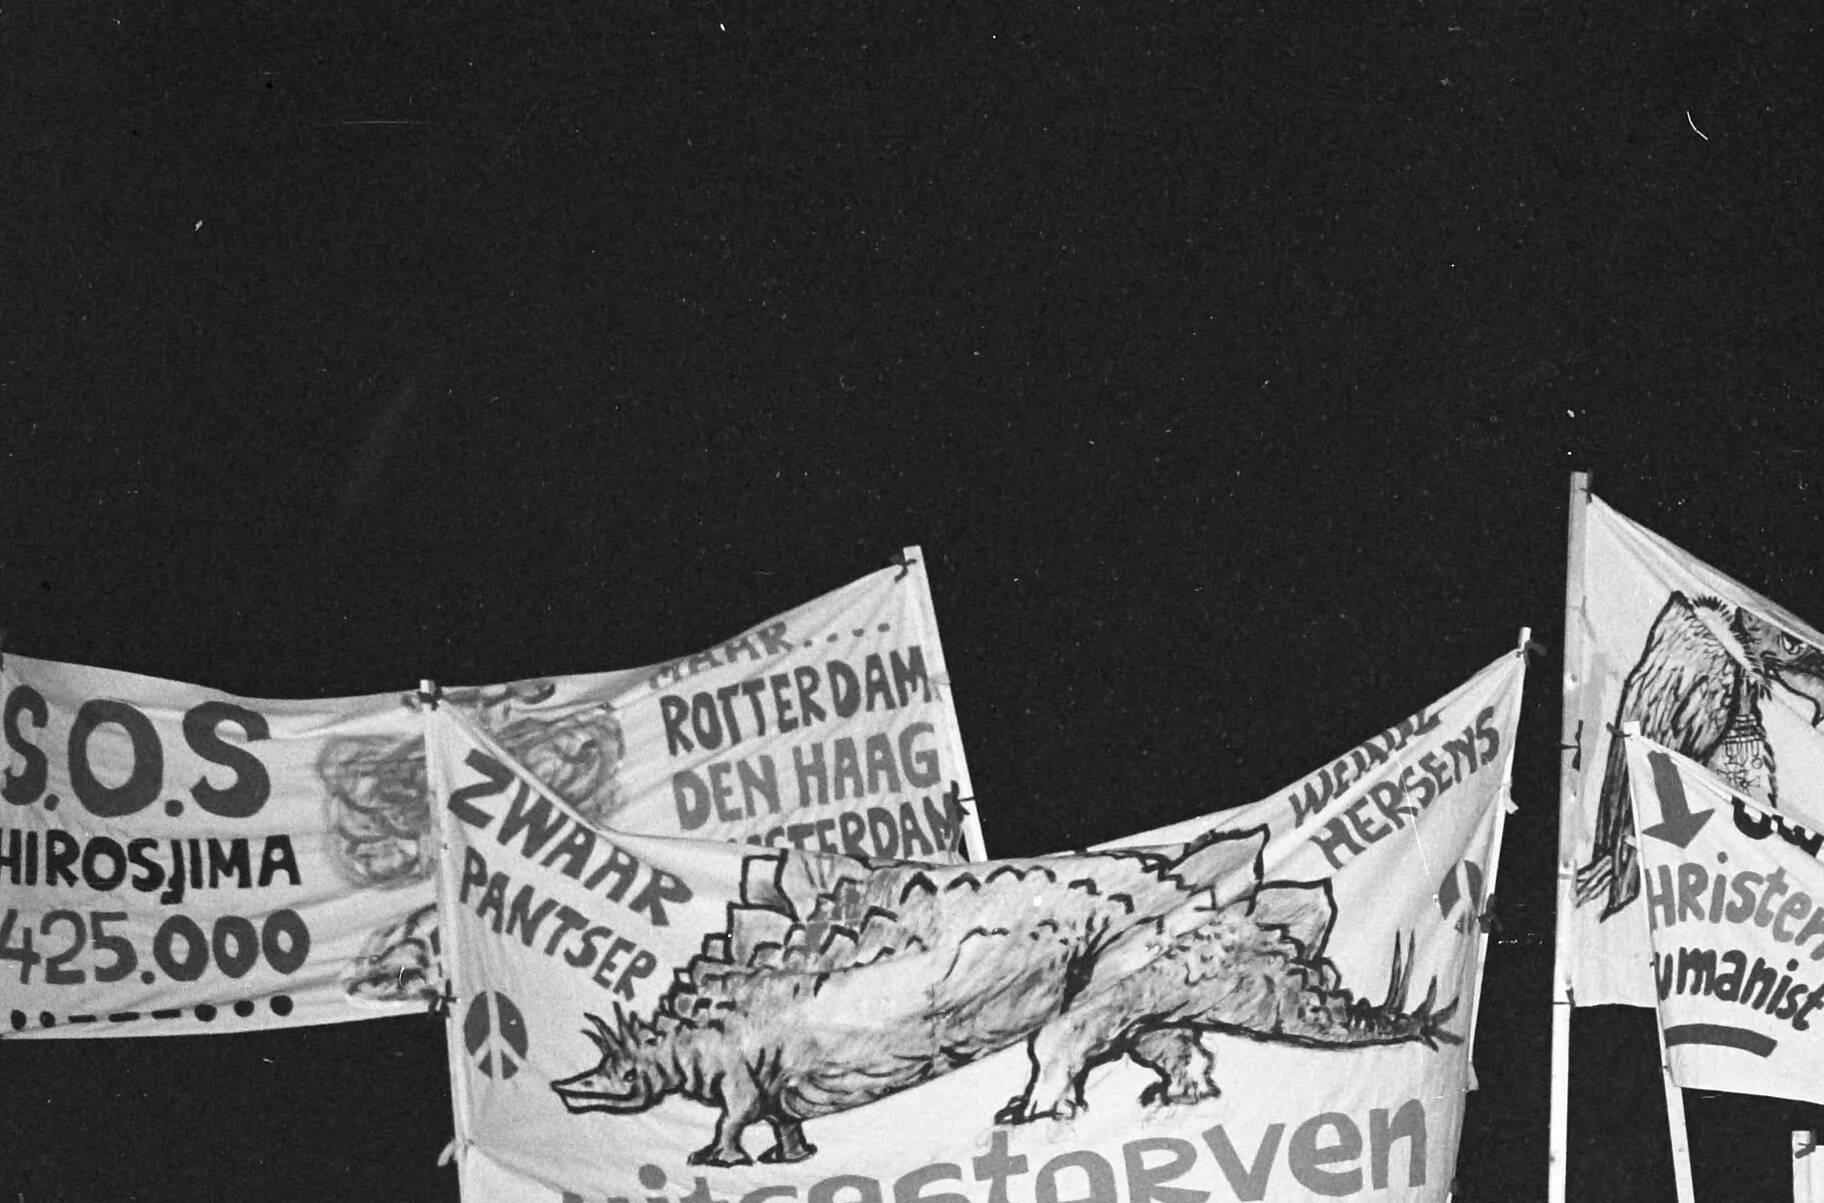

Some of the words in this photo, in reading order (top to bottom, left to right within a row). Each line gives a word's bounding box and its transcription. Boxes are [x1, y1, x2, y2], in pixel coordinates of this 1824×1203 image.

[1, 685, 272, 818] S.O.S
[659, 645, 932, 757] ROTTERDAM
[672, 755, 781, 831] DEN
[792, 721, 941, 808] HAAG
[728, 791, 962, 858] STERDAM
[1308, 705, 1501, 870] HERSENS
[0, 828, 302, 905] HIROSJIMA
[448, 748, 694, 927] ZWAAR
[0, 907, 311, 985] 425.000
[459, 846, 657, 1002] PANTSER
